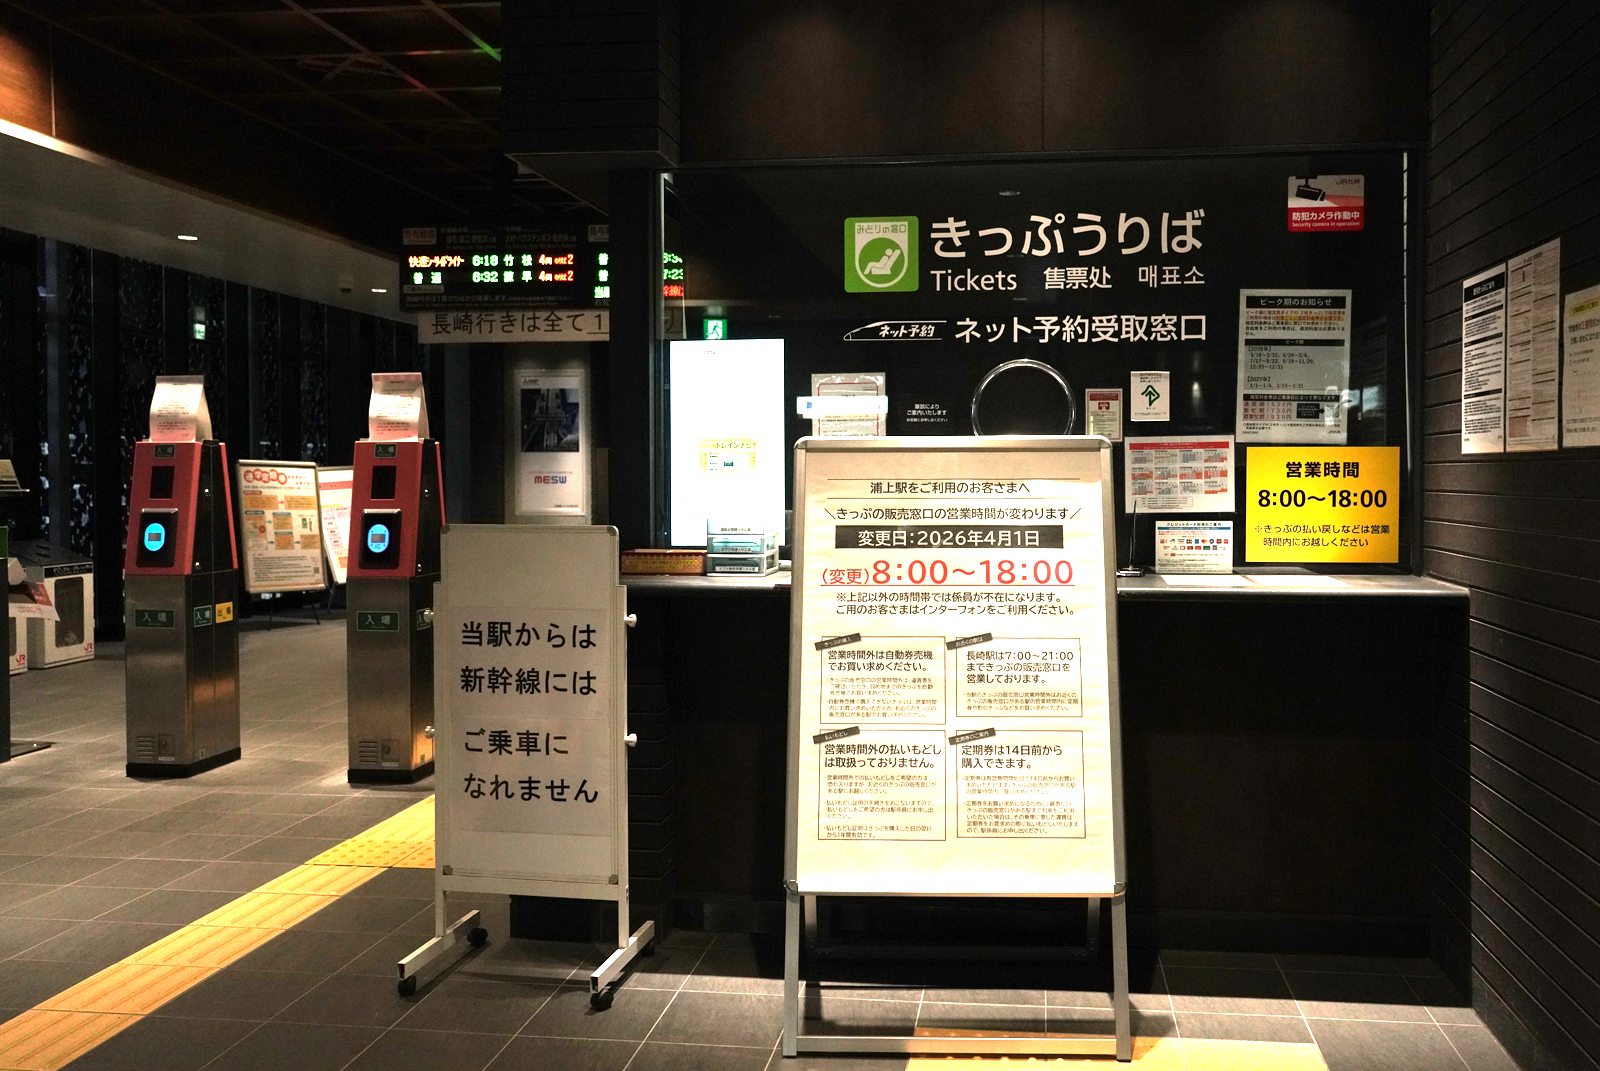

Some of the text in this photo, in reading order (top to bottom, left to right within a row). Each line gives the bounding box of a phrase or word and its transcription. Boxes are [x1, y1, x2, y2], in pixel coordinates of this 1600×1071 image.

[1292, 211, 1360, 221] 防犯カメラ作動中
[856, 223, 907, 235] みどりの窓口
[930, 208, 1206, 258] きっぷうりば
[472, 254, 499, 267] 6:18
[930, 270, 1018, 292] Tickets
[1043, 267, 1113, 290] 售票处
[1138, 265, 1205, 288] 매표소
[1260, 298, 1333, 306] ピーク期のお知らせ
[878, 325, 935, 338] ネット予約
[955, 315, 1207, 343] ネット予約受取窓口
[1285, 461, 1360, 478] 営業時間
[534, 475, 567, 484] MESW
[869, 482, 1031, 494] 浦上駅をご利用のお客さまへ
[836, 508, 1070, 520] きっぷの販売窓口の営業時間が変わります
[1254, 524, 1390, 534] ※きっぷの払い戻しなどは営業
[1263, 537, 1369, 547] 時間内にお越しください
[836, 592, 1062, 603] ※上記以外の時間帯では係員が不在になります。
[836, 604, 1075, 616] ご用のお客さまはインターフォンをご利用ください。
[142, 612, 167, 623] 入場
[365, 615, 391, 626] 入場
[461, 621, 597, 649] 当駅からは
[84, 642, 93, 651] JR
[16, 654, 26, 663] JR
[827, 650, 934, 661] 営業時間外は自動券売機
[827, 662, 928, 671] でお買い求めください。
[966, 662, 1071, 672] まできっぷの販売窓口を
[460, 665, 598, 695] 新幹線には
[966, 674, 1046, 684] 営業しております。
[464, 727, 569, 757] ご乗車に
[824, 731, 848, 741] 払いもどし
[955, 731, 990, 743] 定期券のご案内
[824, 743, 942, 755] 営業時間外の払いもどし
[961, 744, 1063, 756] 定期券は14日前から
[824, 757, 935, 768] は取扱っておりません。
[961, 758, 1032, 769] 購入できます。
[463, 772, 599, 803] なれません
